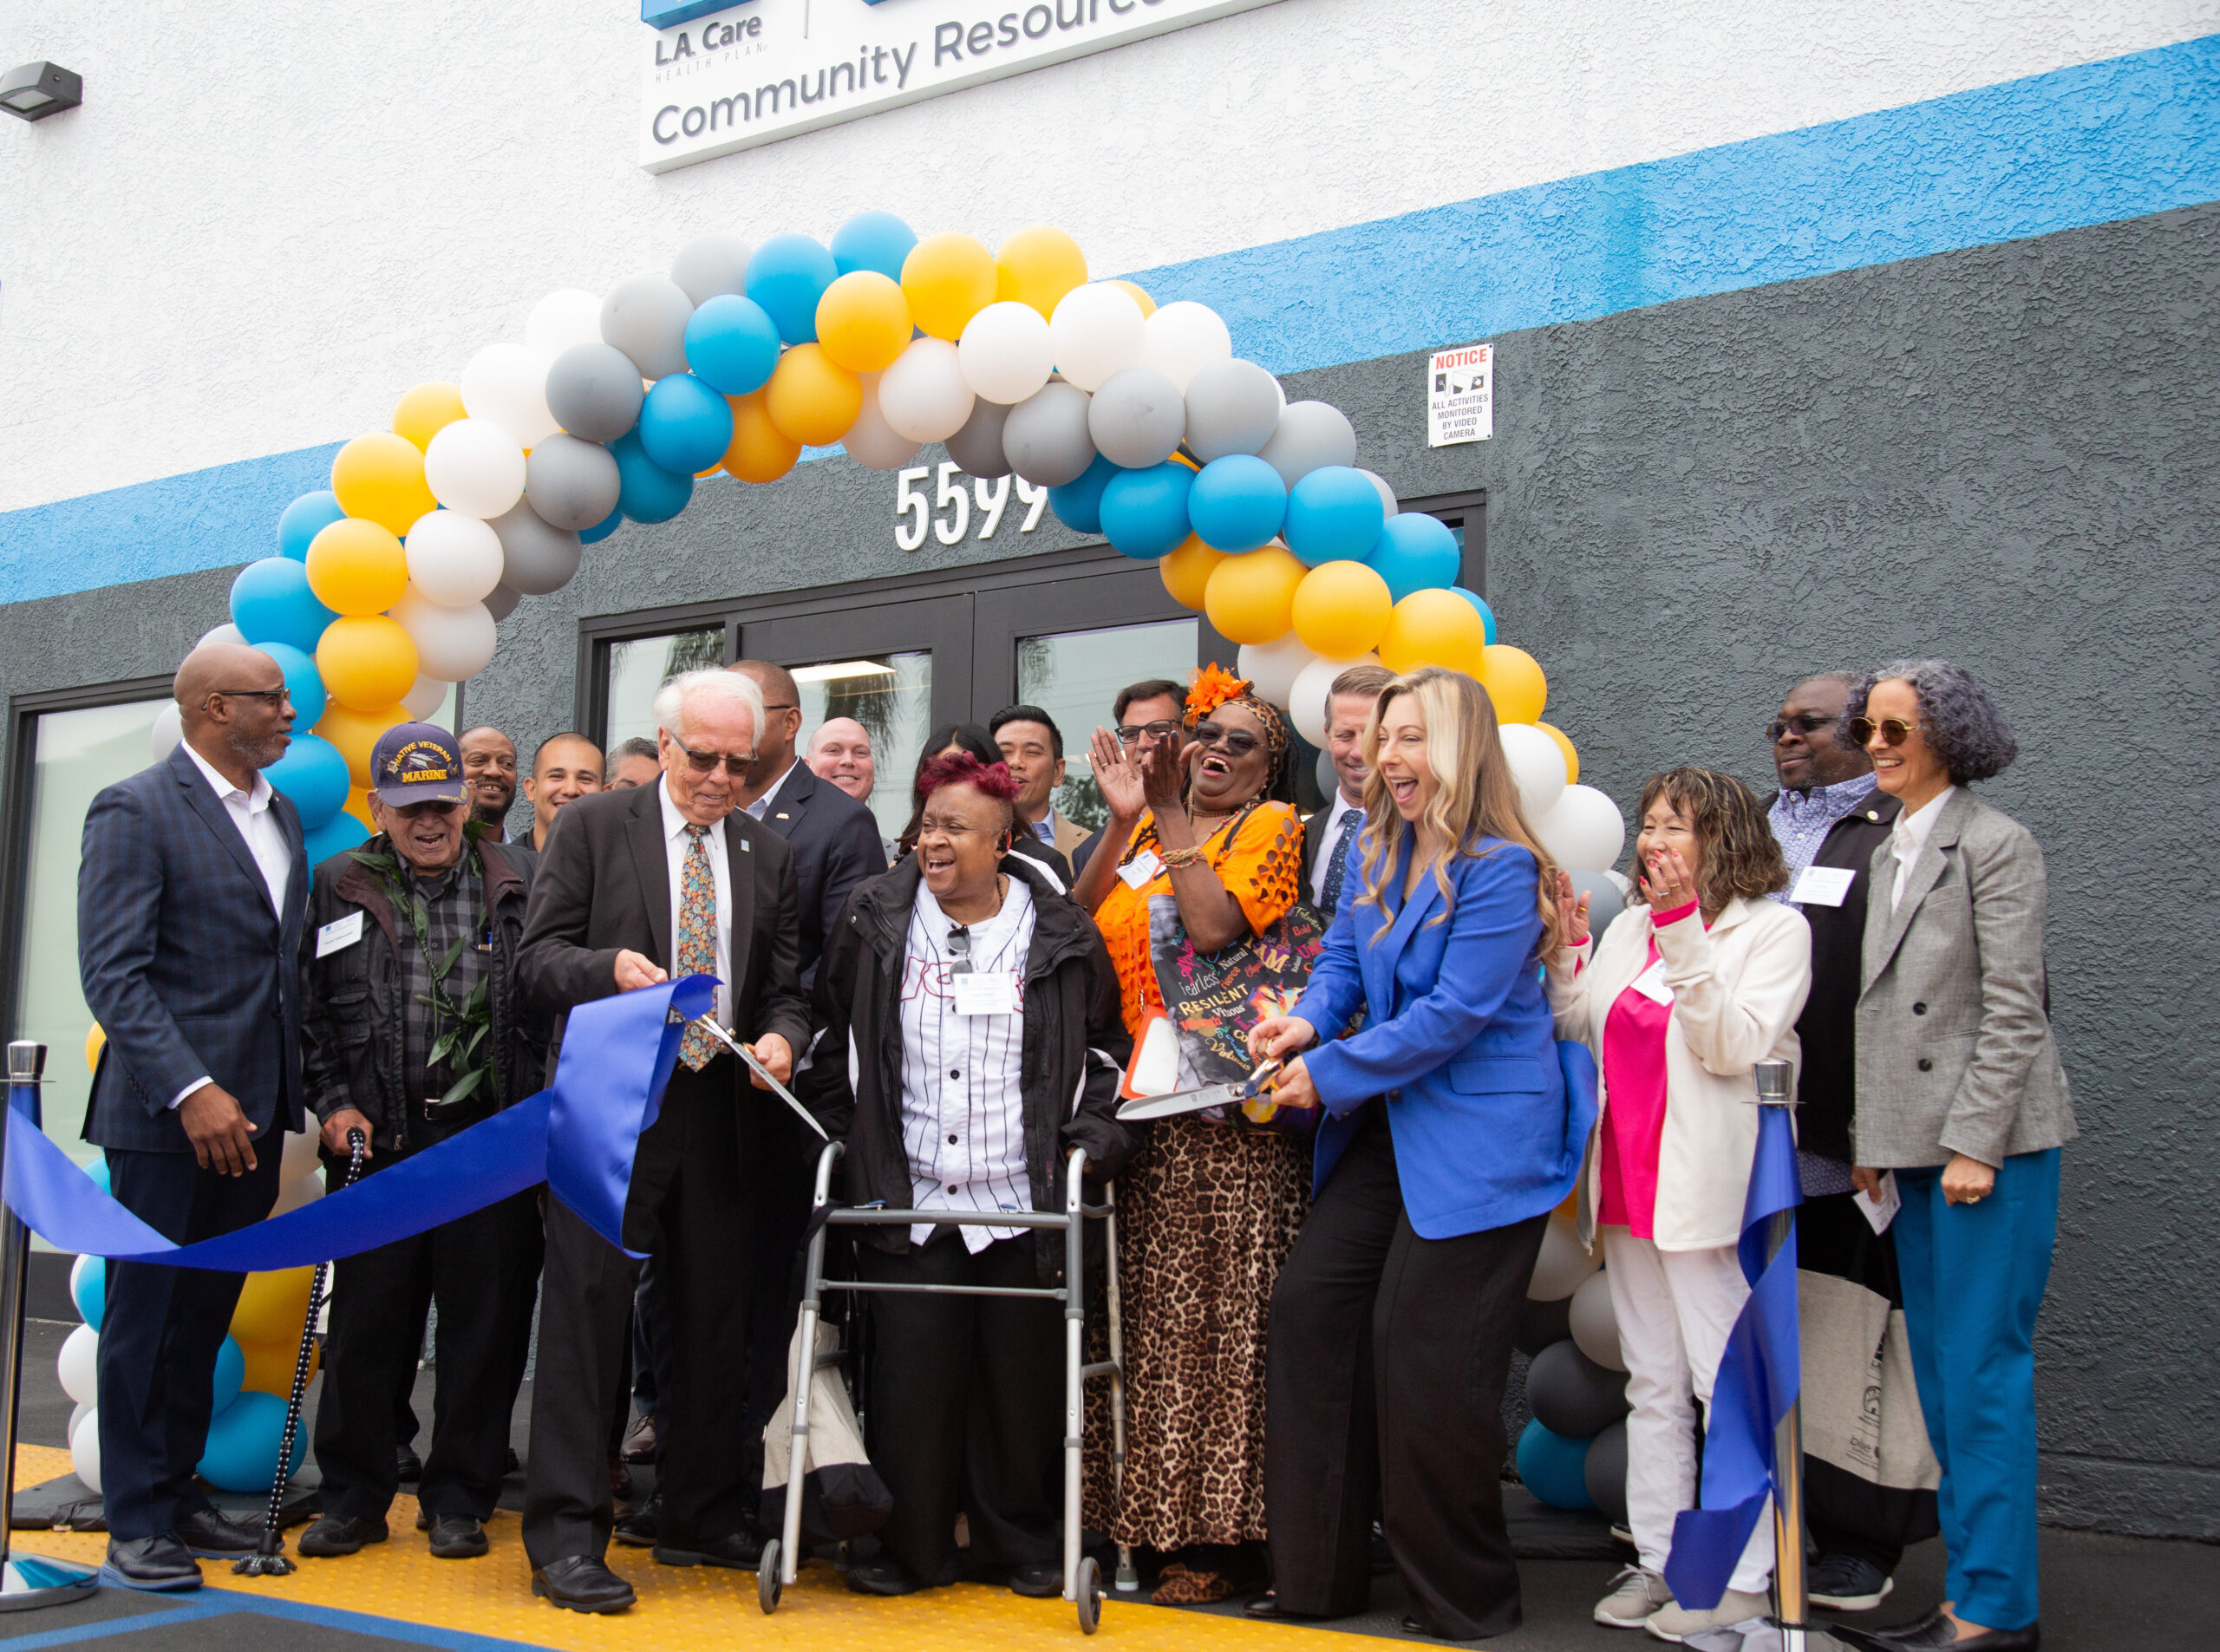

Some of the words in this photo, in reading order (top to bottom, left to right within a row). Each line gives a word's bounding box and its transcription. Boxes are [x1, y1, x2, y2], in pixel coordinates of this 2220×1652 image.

[655, 32, 696, 67] L.A.
[702, 16, 763, 50] Care
[656, 57, 712, 84] HEALTH
[724, 42, 763, 63] PLAN
[651, 41, 919, 146] Community
[1435, 348, 1487, 370] NOTICE
[1432, 401, 1446, 410] ALL
[1447, 394, 1489, 408] ACTIVITIES
[1438, 405, 1483, 420] MONITORED
[1442, 420, 1453, 430] BY
[1453, 416, 1478, 428] VIDEO
[1443, 428, 1476, 441] CAMERA
[895, 461, 1048, 552] 5599
[394, 742, 417, 767] NATIVE
[418, 741, 452, 762] VETERAN
[402, 769, 447, 783] MARINE
[1292, 924, 1312, 937] Bold
[1218, 947, 1249, 970] Natural
[1252, 943, 1290, 973] AM
